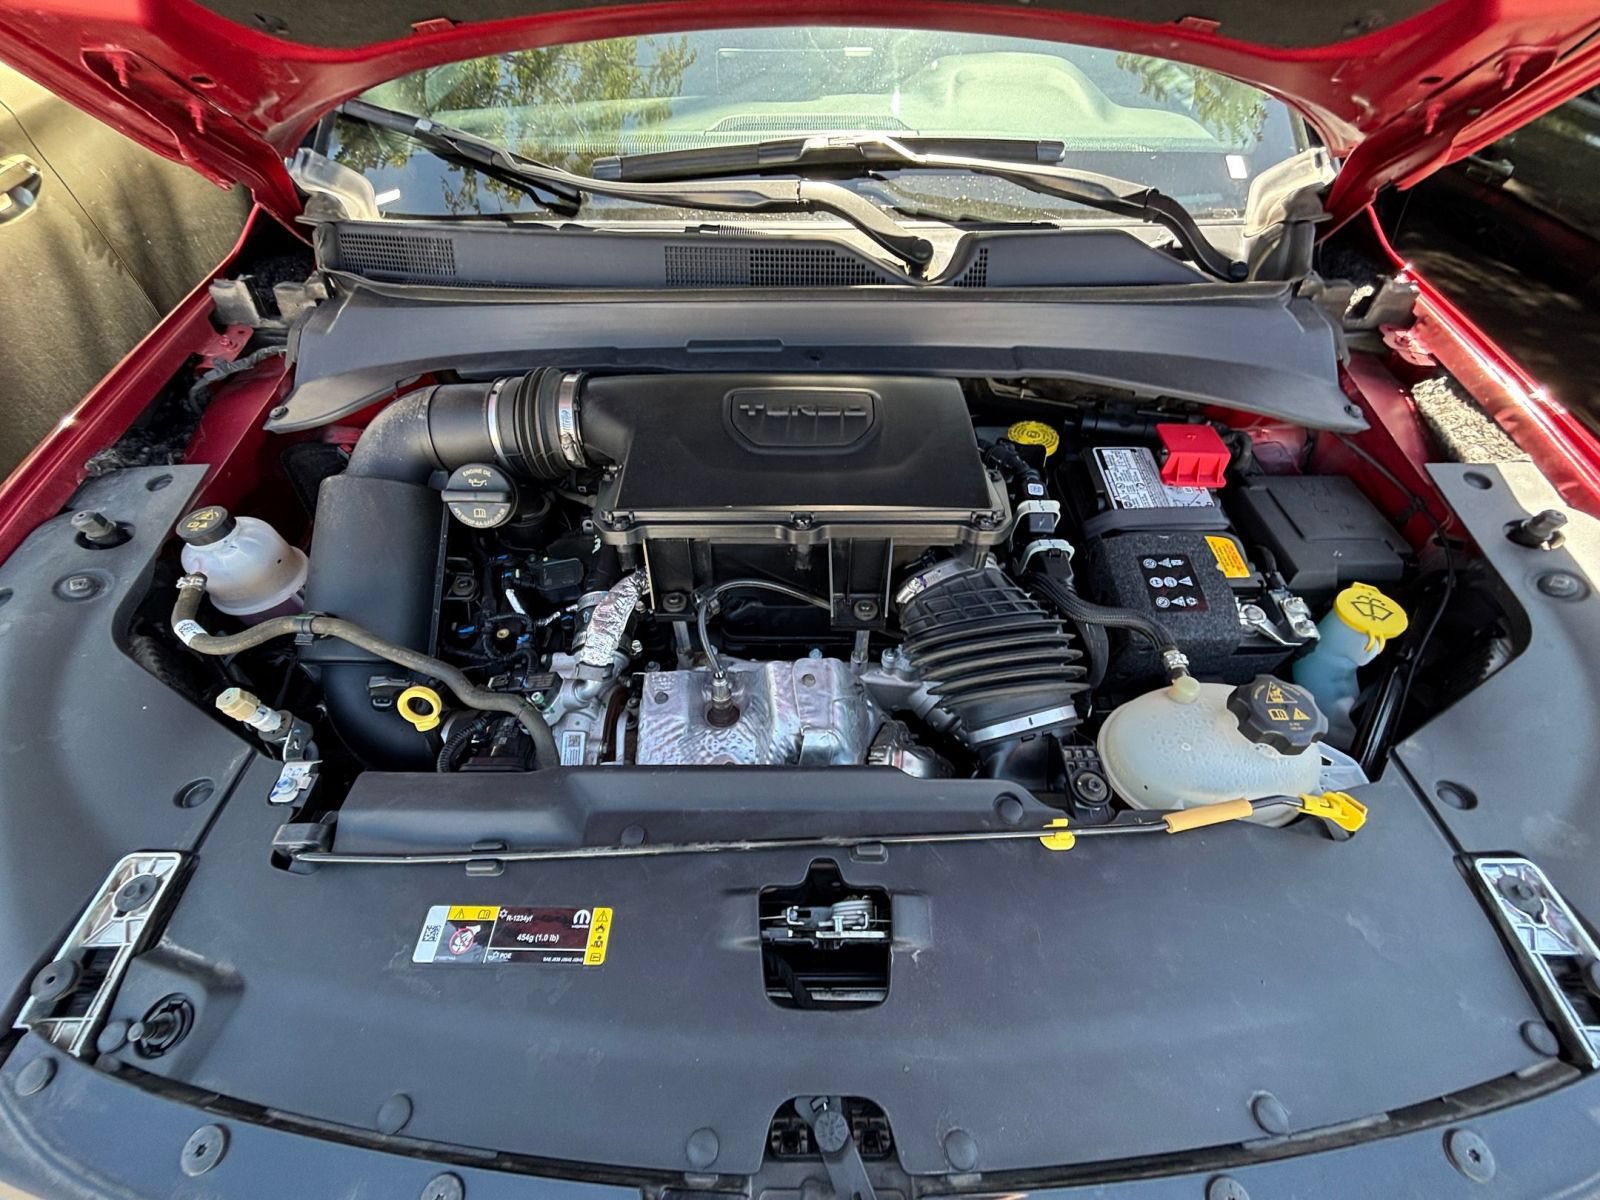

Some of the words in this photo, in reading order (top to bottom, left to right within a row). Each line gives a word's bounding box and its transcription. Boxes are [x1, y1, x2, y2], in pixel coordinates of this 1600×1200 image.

[462, 468, 482, 477] ENGINE
[483, 469, 491, 477] OIL
[506, 914, 533, 923] R-1234yf
[516, 933, 534, 943] 454g
[535, 933, 549, 943] (1.0
[549, 933, 559, 944] lb)
